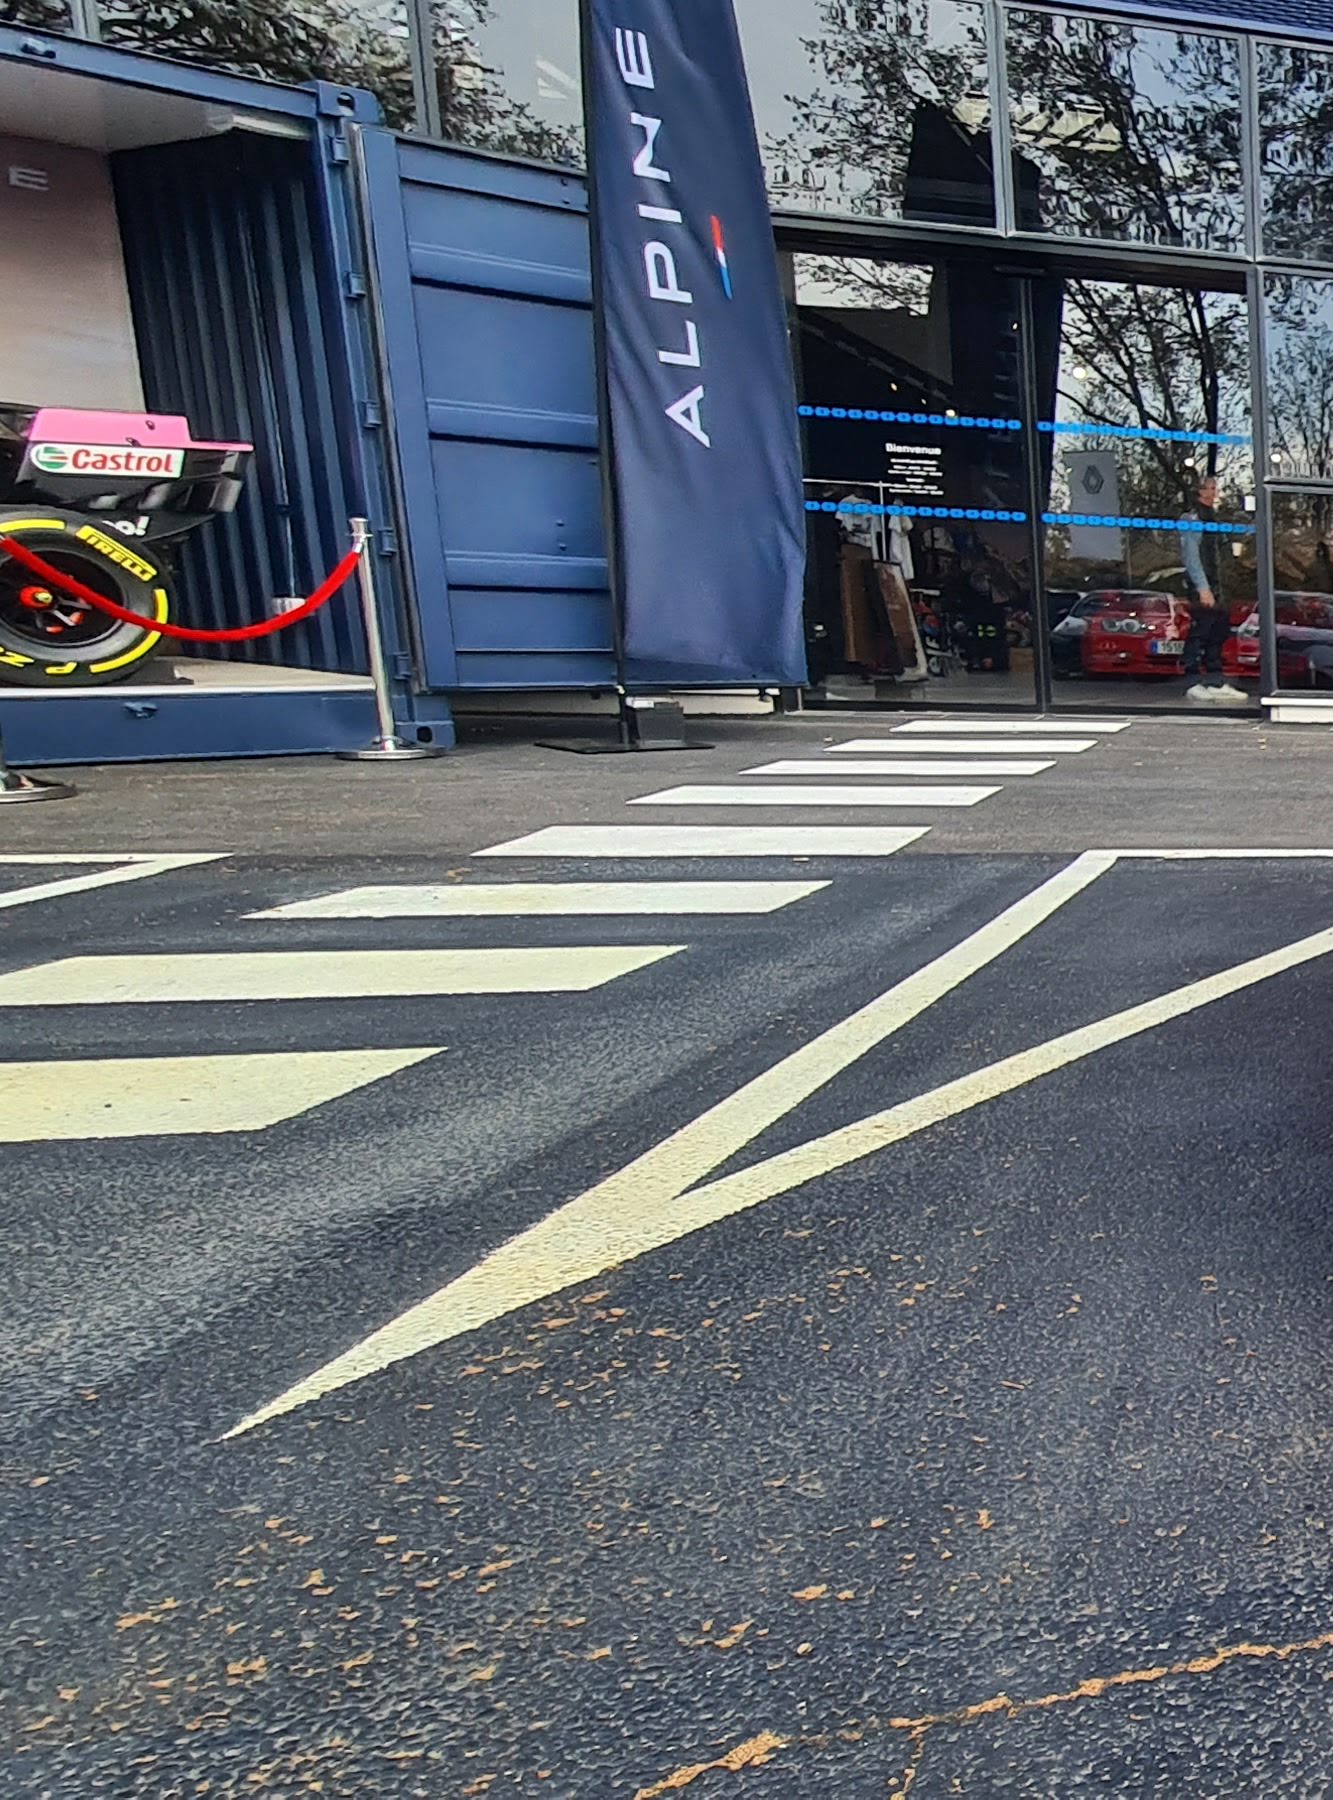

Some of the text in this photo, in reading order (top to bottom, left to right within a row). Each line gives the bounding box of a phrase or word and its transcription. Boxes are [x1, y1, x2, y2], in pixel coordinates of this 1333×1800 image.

[614, 26, 713, 449] ALPINE
[72, 449, 174, 474] Castrol
[885, 443, 942, 455] Bienvenue
[75, 525, 158, 582] PIRELLI
